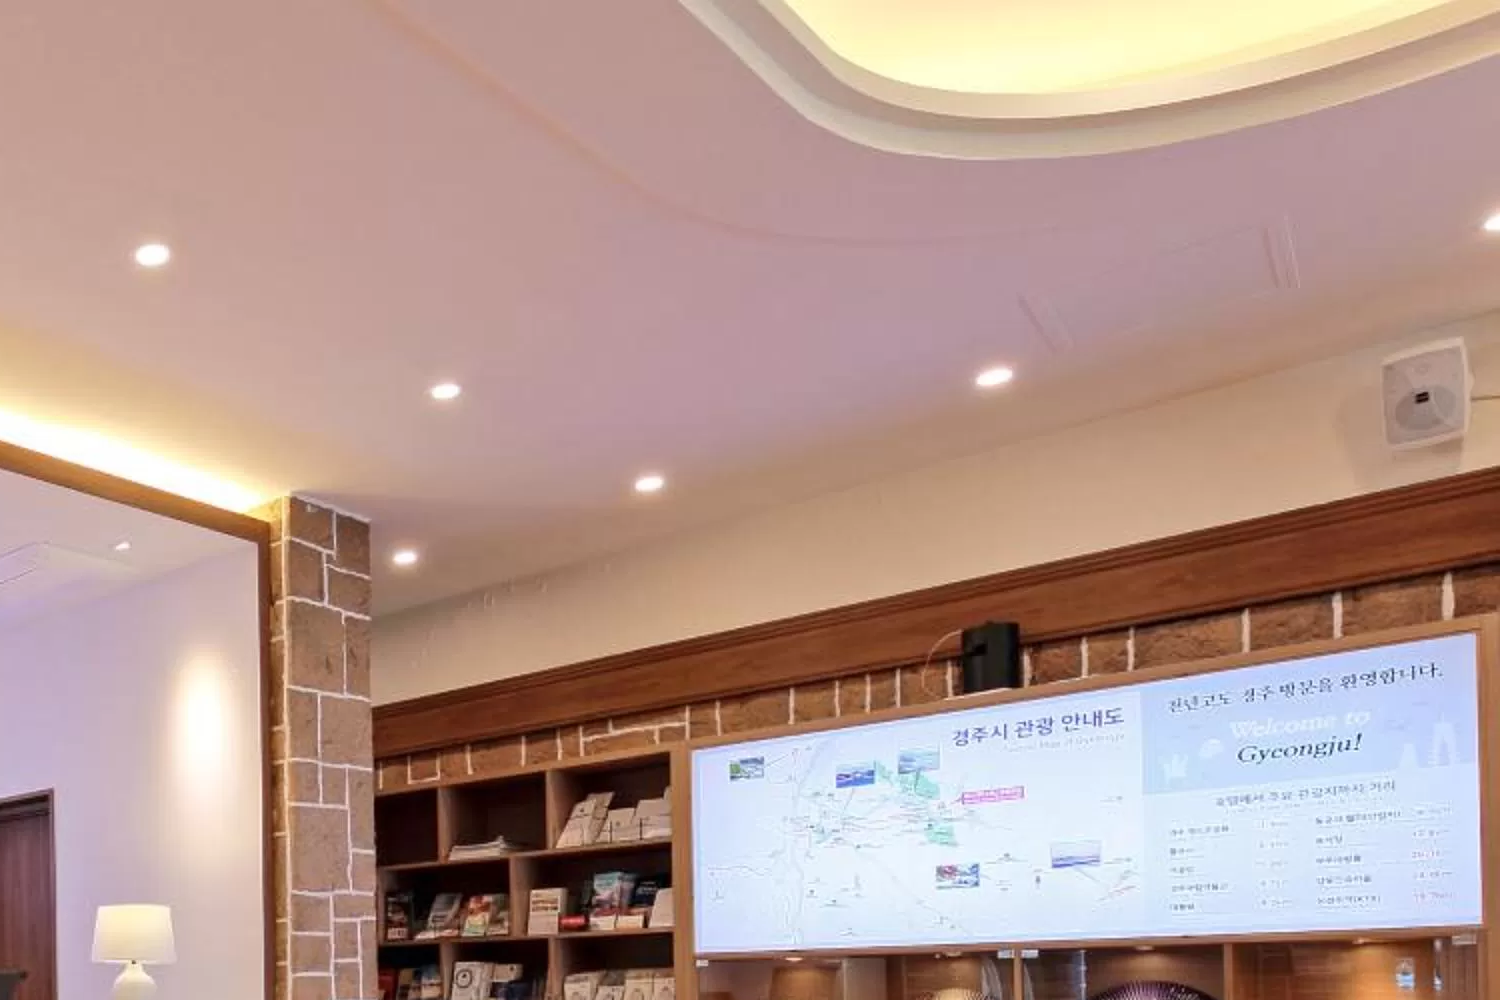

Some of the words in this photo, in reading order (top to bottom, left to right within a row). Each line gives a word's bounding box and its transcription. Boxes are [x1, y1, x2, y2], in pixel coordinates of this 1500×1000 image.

[1242, 685, 1275, 704] 경주
[1279, 677, 1333, 697] 방문을
[1340, 662, 1444, 689] 환영합니다.
[952, 723, 1008, 747] 경주시
[1014, 716, 1055, 739] 관광
[1061, 707, 1125, 733] 안내도
[1229, 715, 1337, 739] Welcome
[1345, 711, 1371, 726] to
[1236, 732, 1363, 765] Gyeongju!
